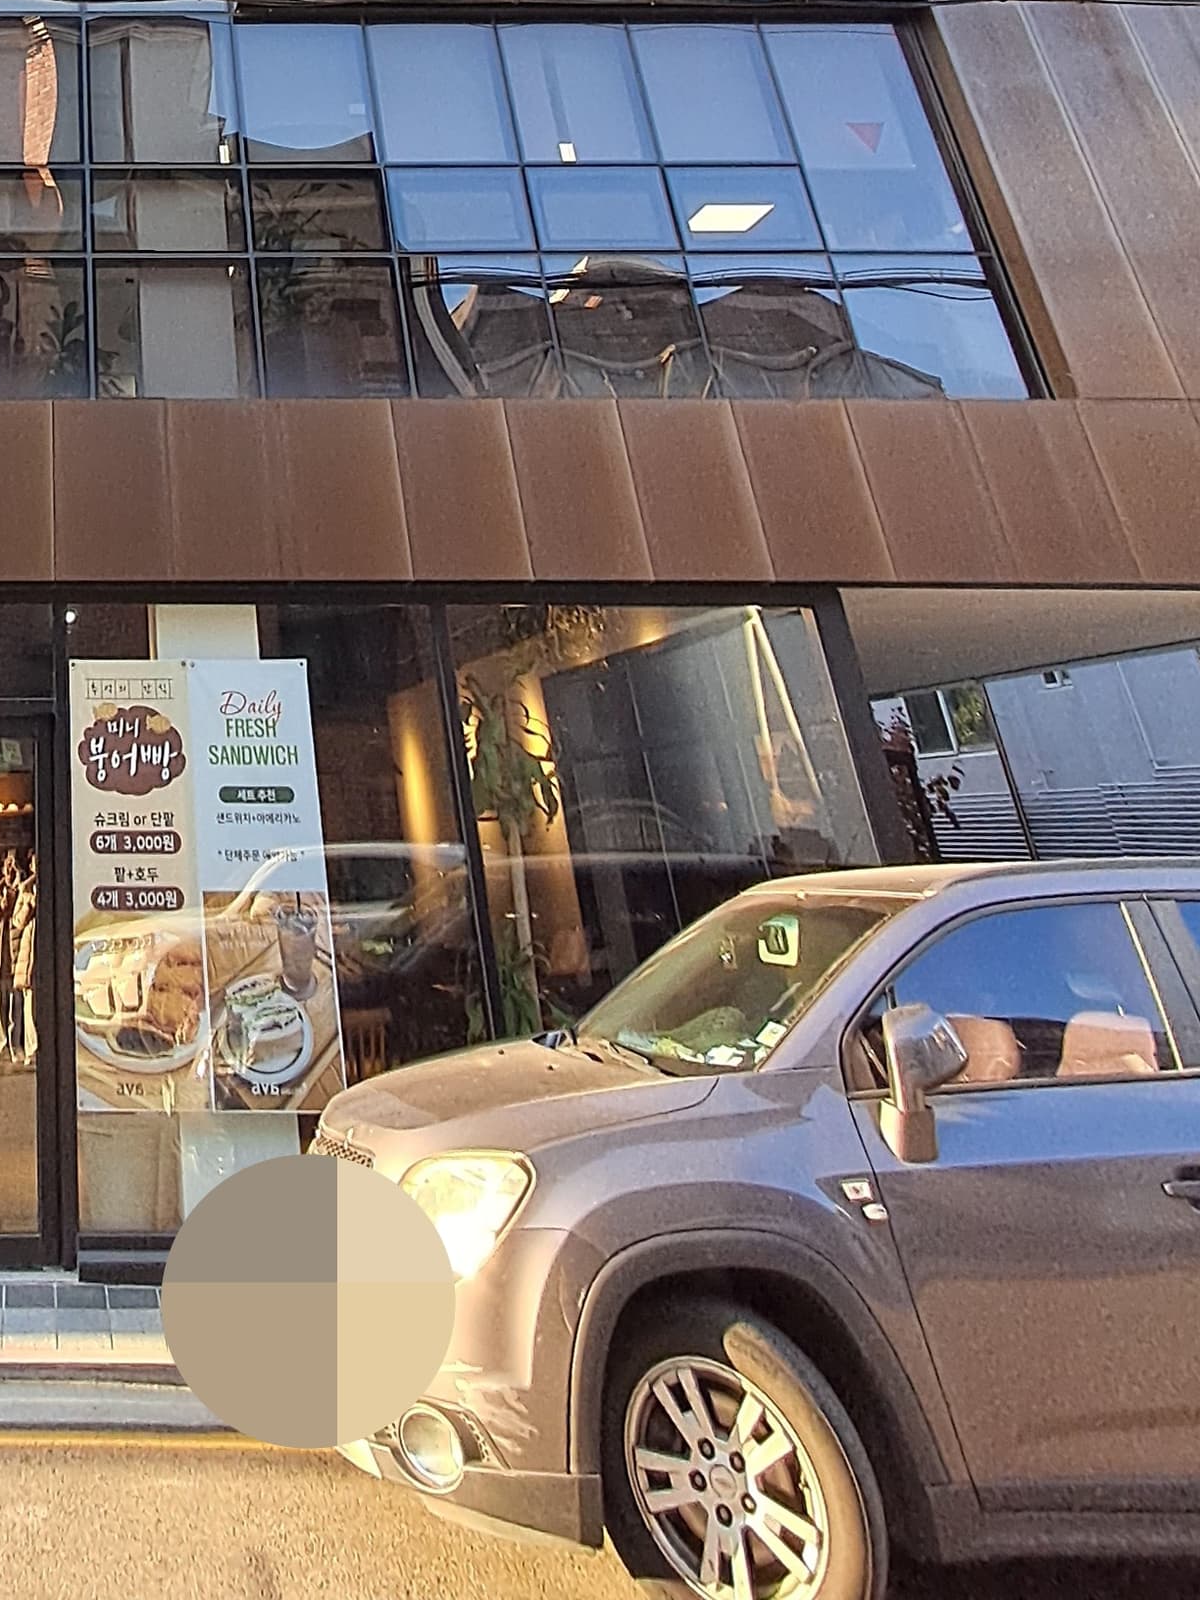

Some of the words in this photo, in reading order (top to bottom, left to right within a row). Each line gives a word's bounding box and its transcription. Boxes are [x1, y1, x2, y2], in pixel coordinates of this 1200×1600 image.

[220, 689, 282, 723] Daily
[107, 717, 139, 738] 미니
[225, 718, 277, 738] FRESH
[88, 736, 179, 782] 붕어빵
[208, 744, 299, 766] SANDWICH
[237, 788, 256, 802] 세트
[257, 788, 276, 802] 추천
[94, 811, 130, 827] 슈크림
[133, 815, 147, 826] or
[150, 811, 175, 827] 단팥
[95, 834, 117, 852] 6개
[123, 834, 175, 852] 3,000원
[224, 848, 260, 862] 단체주문
[114, 866, 158, 883] 팥+호두
[96, 890, 119, 908] 4개
[125, 890, 177, 909] 3,000원
